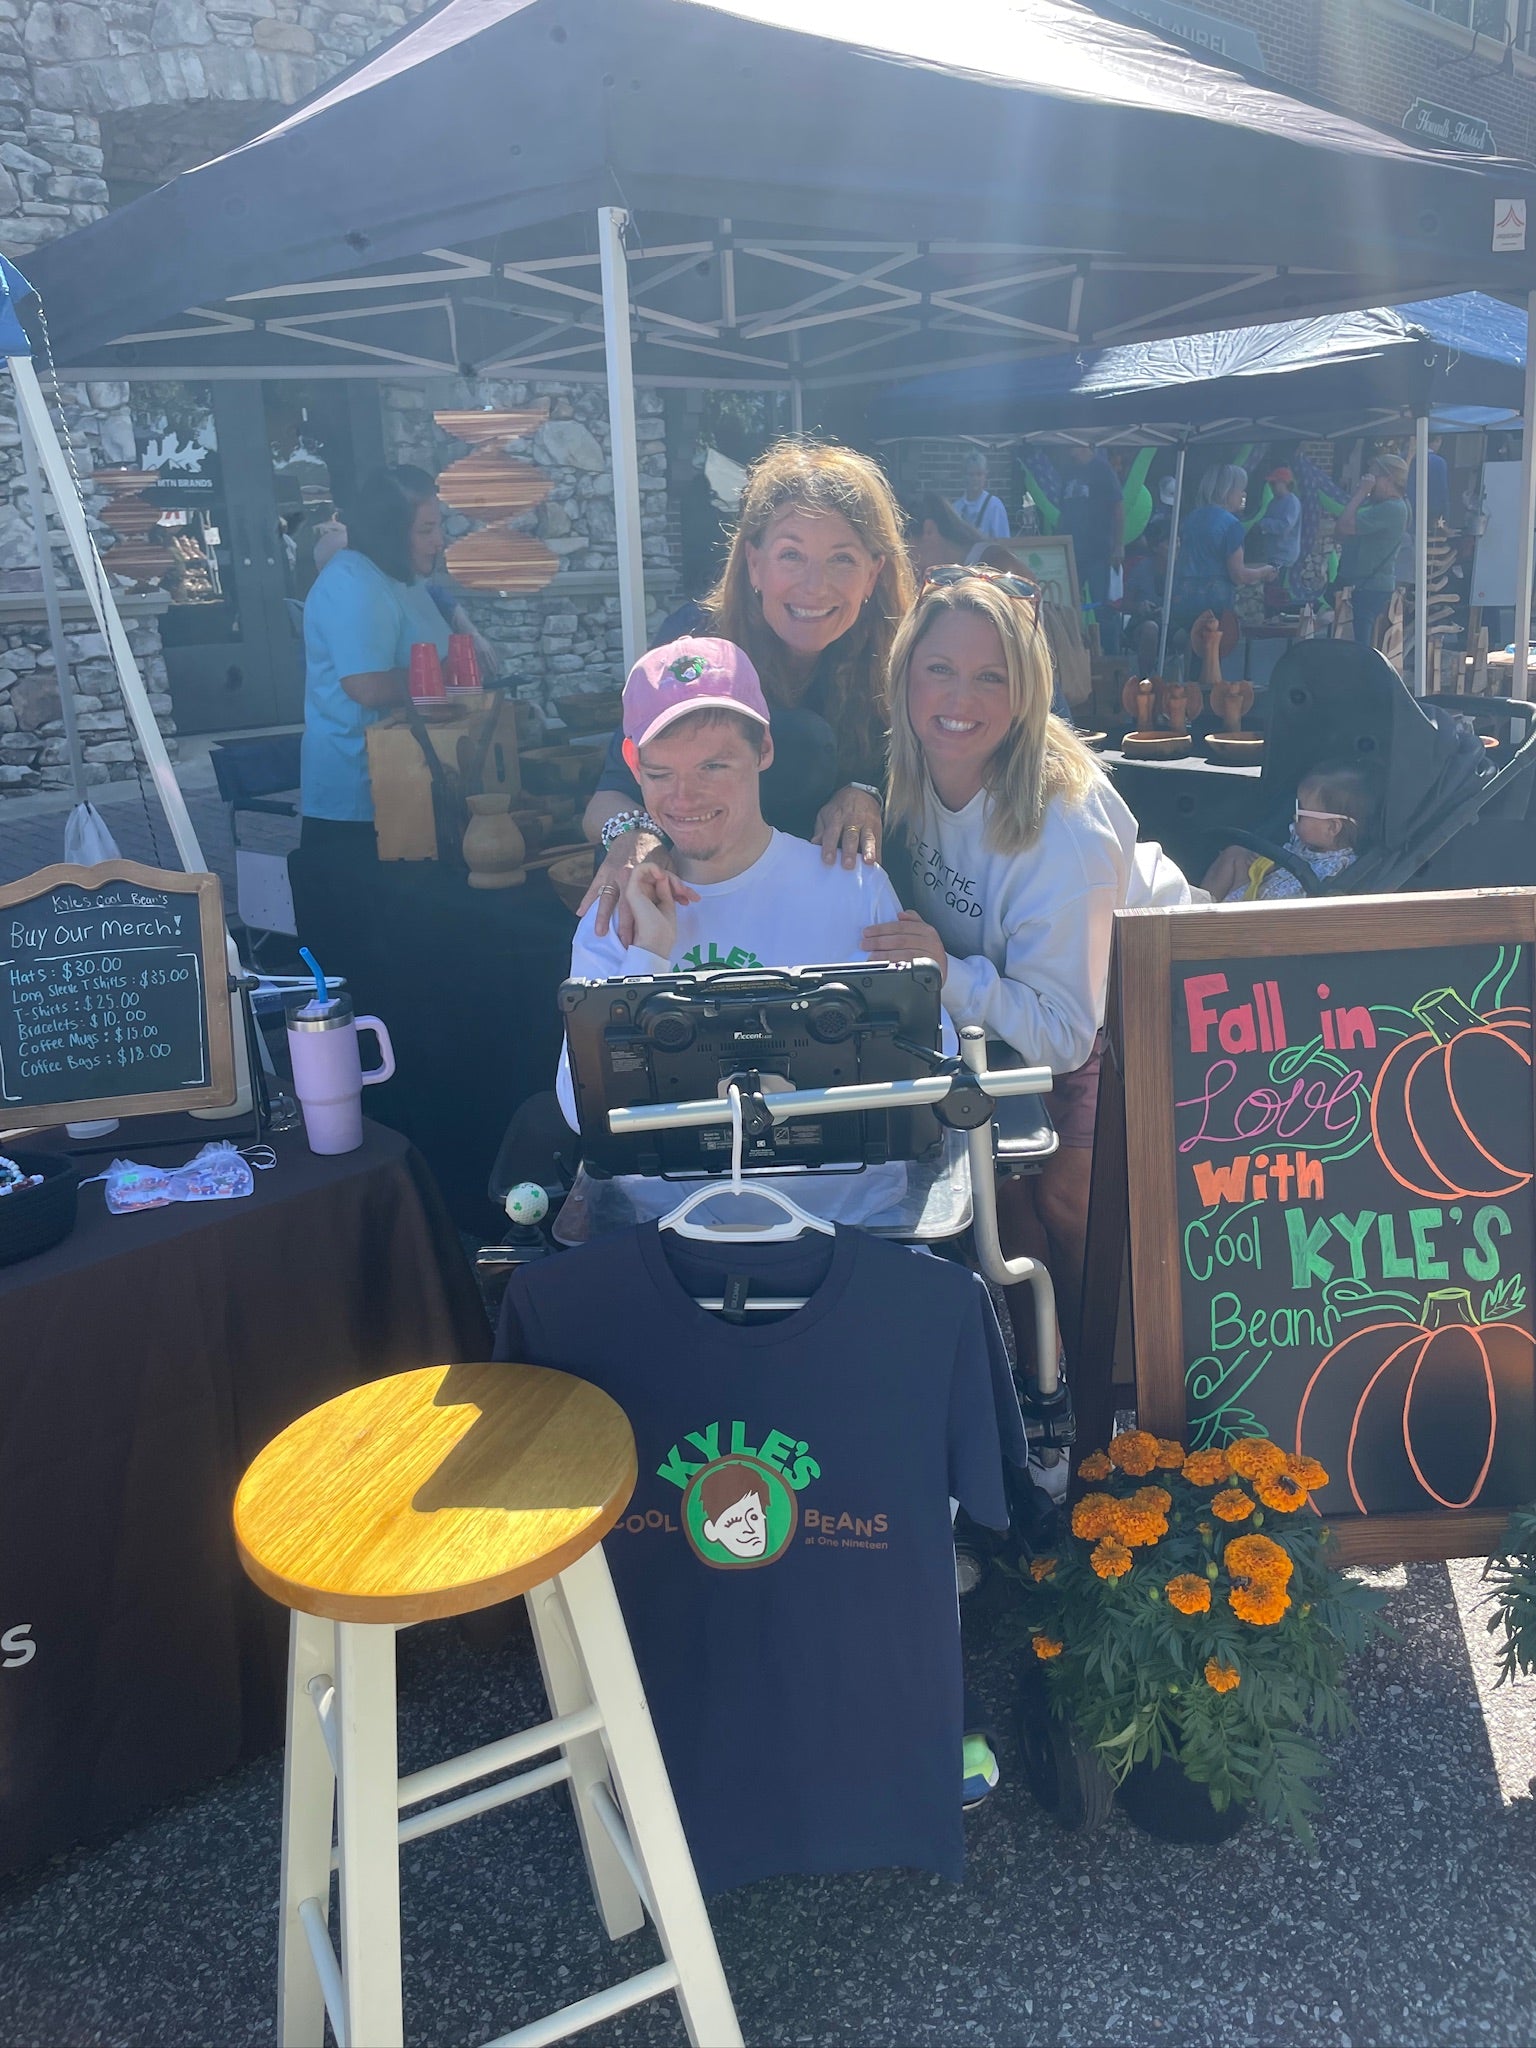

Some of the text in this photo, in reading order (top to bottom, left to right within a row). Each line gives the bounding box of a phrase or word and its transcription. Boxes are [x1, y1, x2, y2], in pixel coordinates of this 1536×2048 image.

[178, 479, 213, 487] BRANDS
[927, 849, 943, 871] IN
[944, 866, 976, 896] THE
[96, 893, 121, 907] Cool
[923, 871, 943, 890] OF
[945, 891, 982, 917] GOD
[10, 915, 181, 950] Buy Our Merch!
[12, 989, 44, 1005] Long
[49, 983, 78, 998] Sleeve
[139, 968, 189, 989] $35.00
[62, 957, 122, 982] $30.00
[83, 991, 140, 1012] $25.00
[1183, 972, 1377, 1053] Fall in
[18, 1037, 65, 1057] Coffee
[115, 1025, 158, 1043] $15.00
[21, 1058, 62, 1078] Coffee
[117, 1043, 172, 1067] $18.00
[1175, 1059, 1363, 1152] Love
[1184, 1206, 1512, 1289] Cool KYLE'S
[1211, 1292, 1336, 1351] Beans
[656, 1420, 821, 1491] KYLE'S
[804, 1508, 889, 1538] BEANS
[805, 1536, 889, 1550] at One Nineteen
